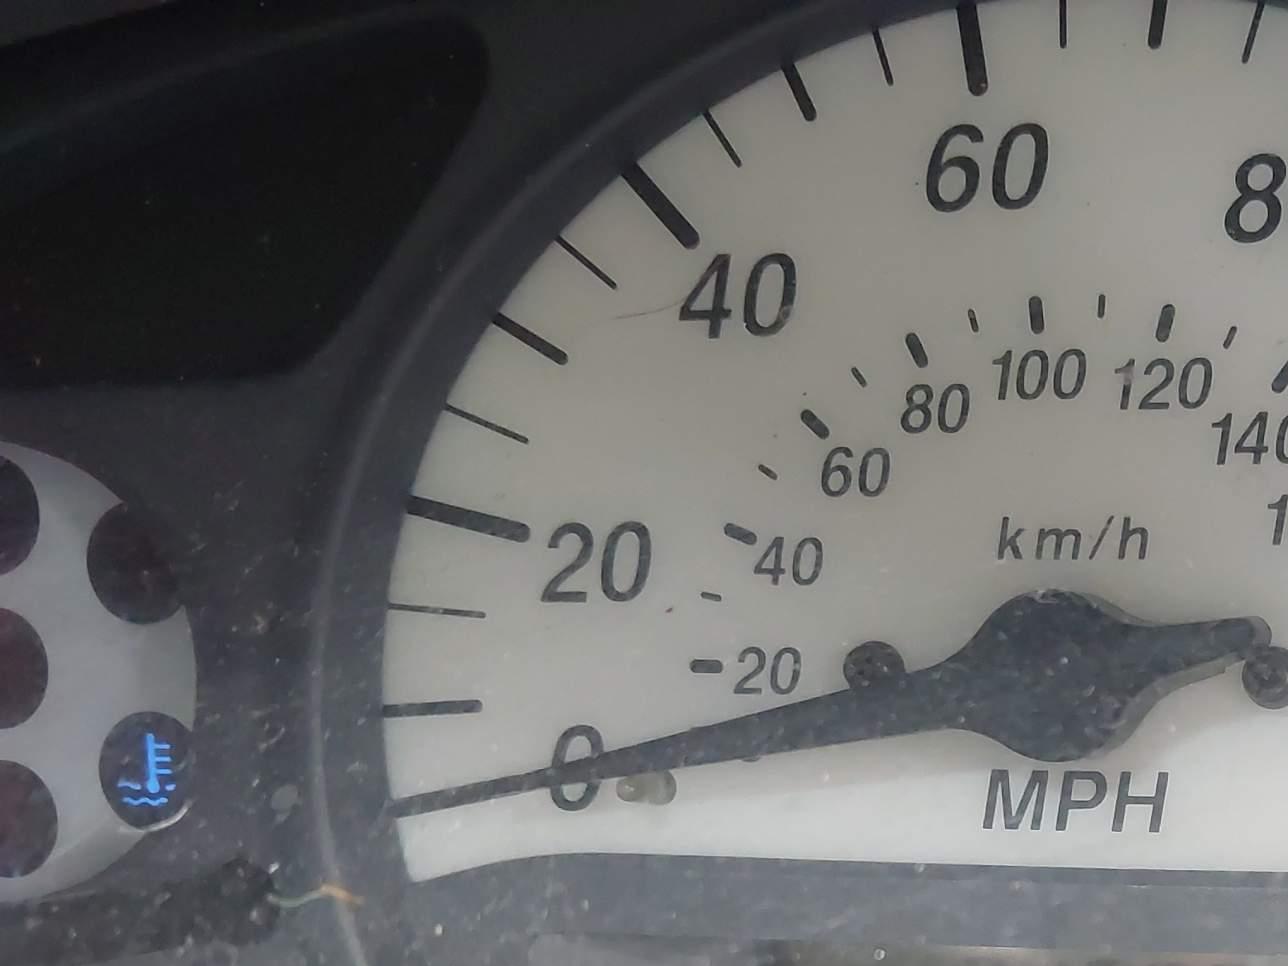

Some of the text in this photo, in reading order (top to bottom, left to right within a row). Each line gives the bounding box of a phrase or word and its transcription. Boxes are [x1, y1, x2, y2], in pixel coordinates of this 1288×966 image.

[926, 123, 1048, 212] 60
[679, 253, 796, 338] 40
[992, 349, 1086, 400] 100
[1115, 358, 1212, 410] 120
[901, 384, 969, 433] 80
[821, 447, 890, 497] 60
[541, 521, 651, 602] 20
[754, 537, 823, 585] 40
[998, 516, 1148, 560] km/h
[734, 647, 801, 695] 20
[983, 767, 1168, 832] MPH
